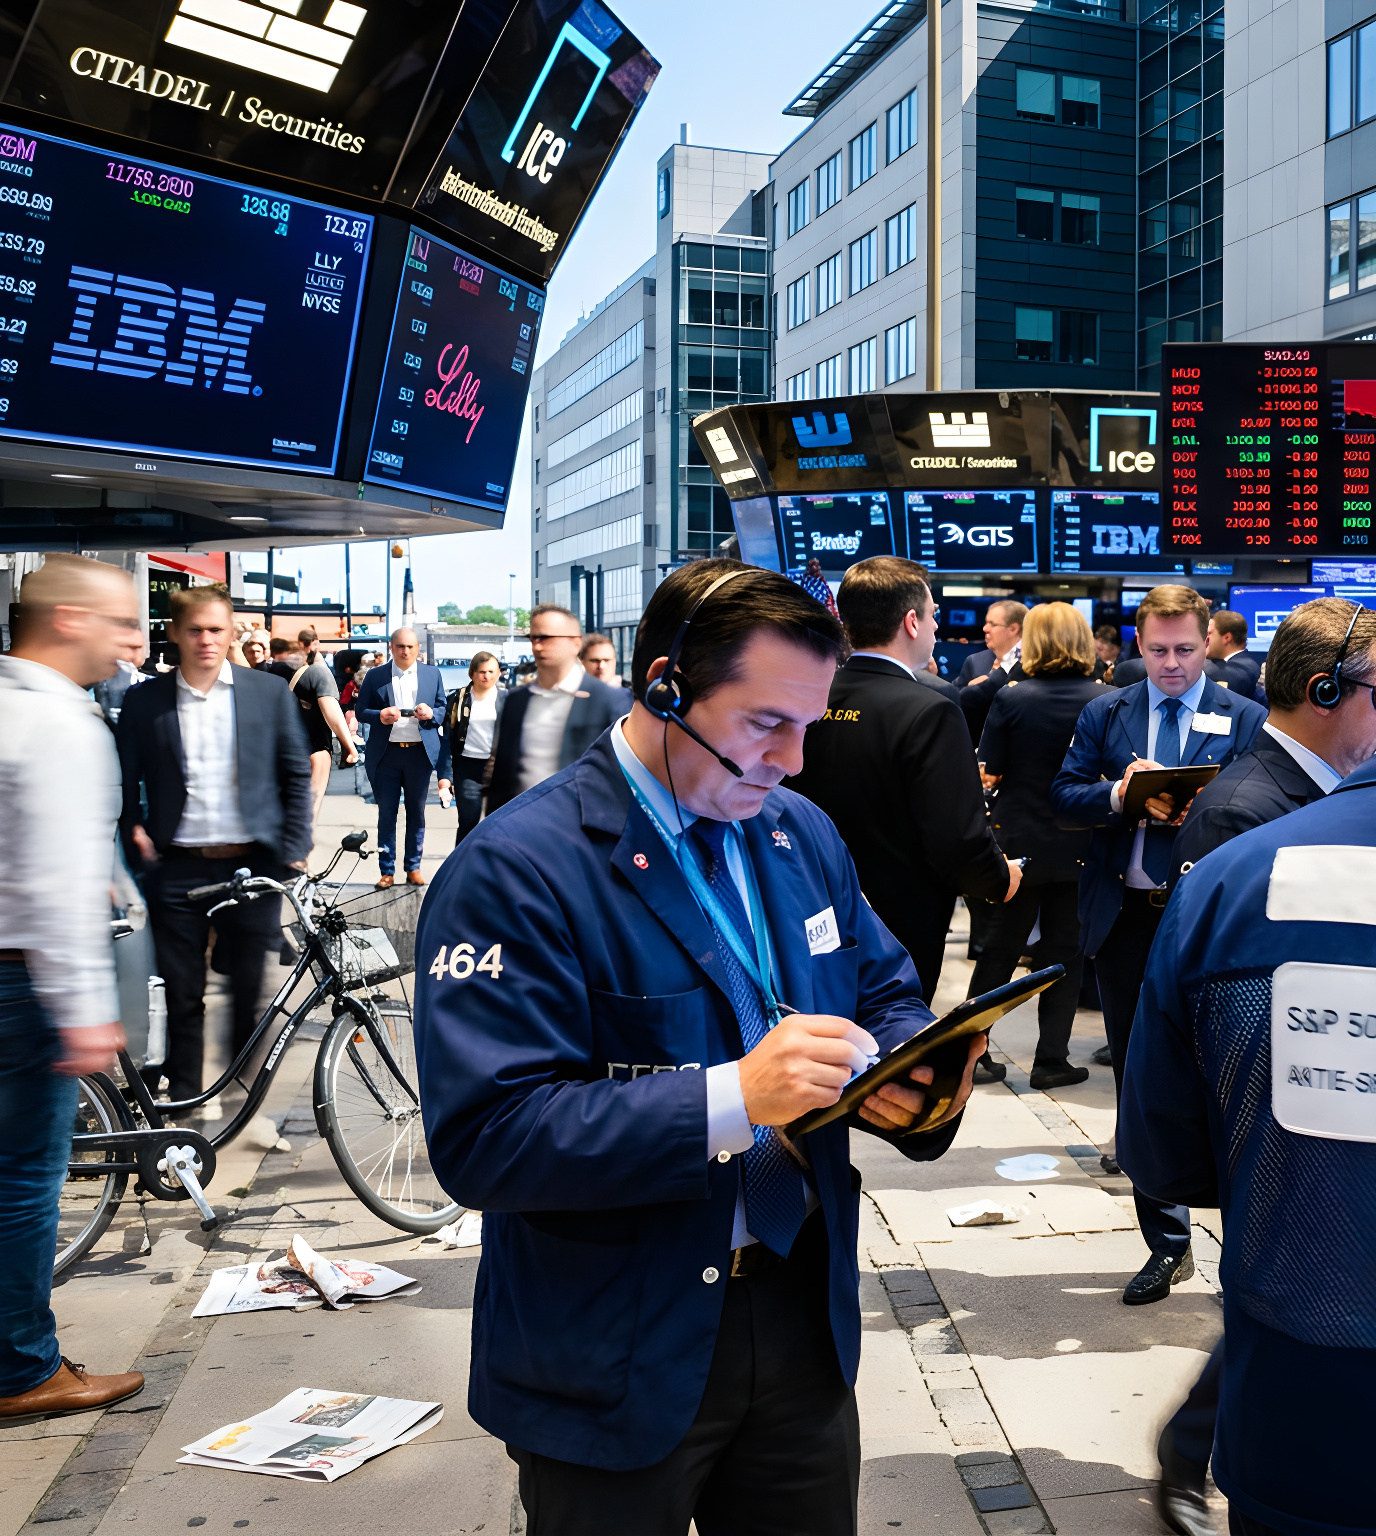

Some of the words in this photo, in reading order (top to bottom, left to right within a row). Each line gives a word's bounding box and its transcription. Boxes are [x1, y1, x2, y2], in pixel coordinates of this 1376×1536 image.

[70, 46, 212, 111] CITADEL
[238, 96, 366, 154] Securities
[50, 264, 266, 395] IBM
[1091, 524, 1160, 555] IBM
[428, 942, 504, 981] 464
